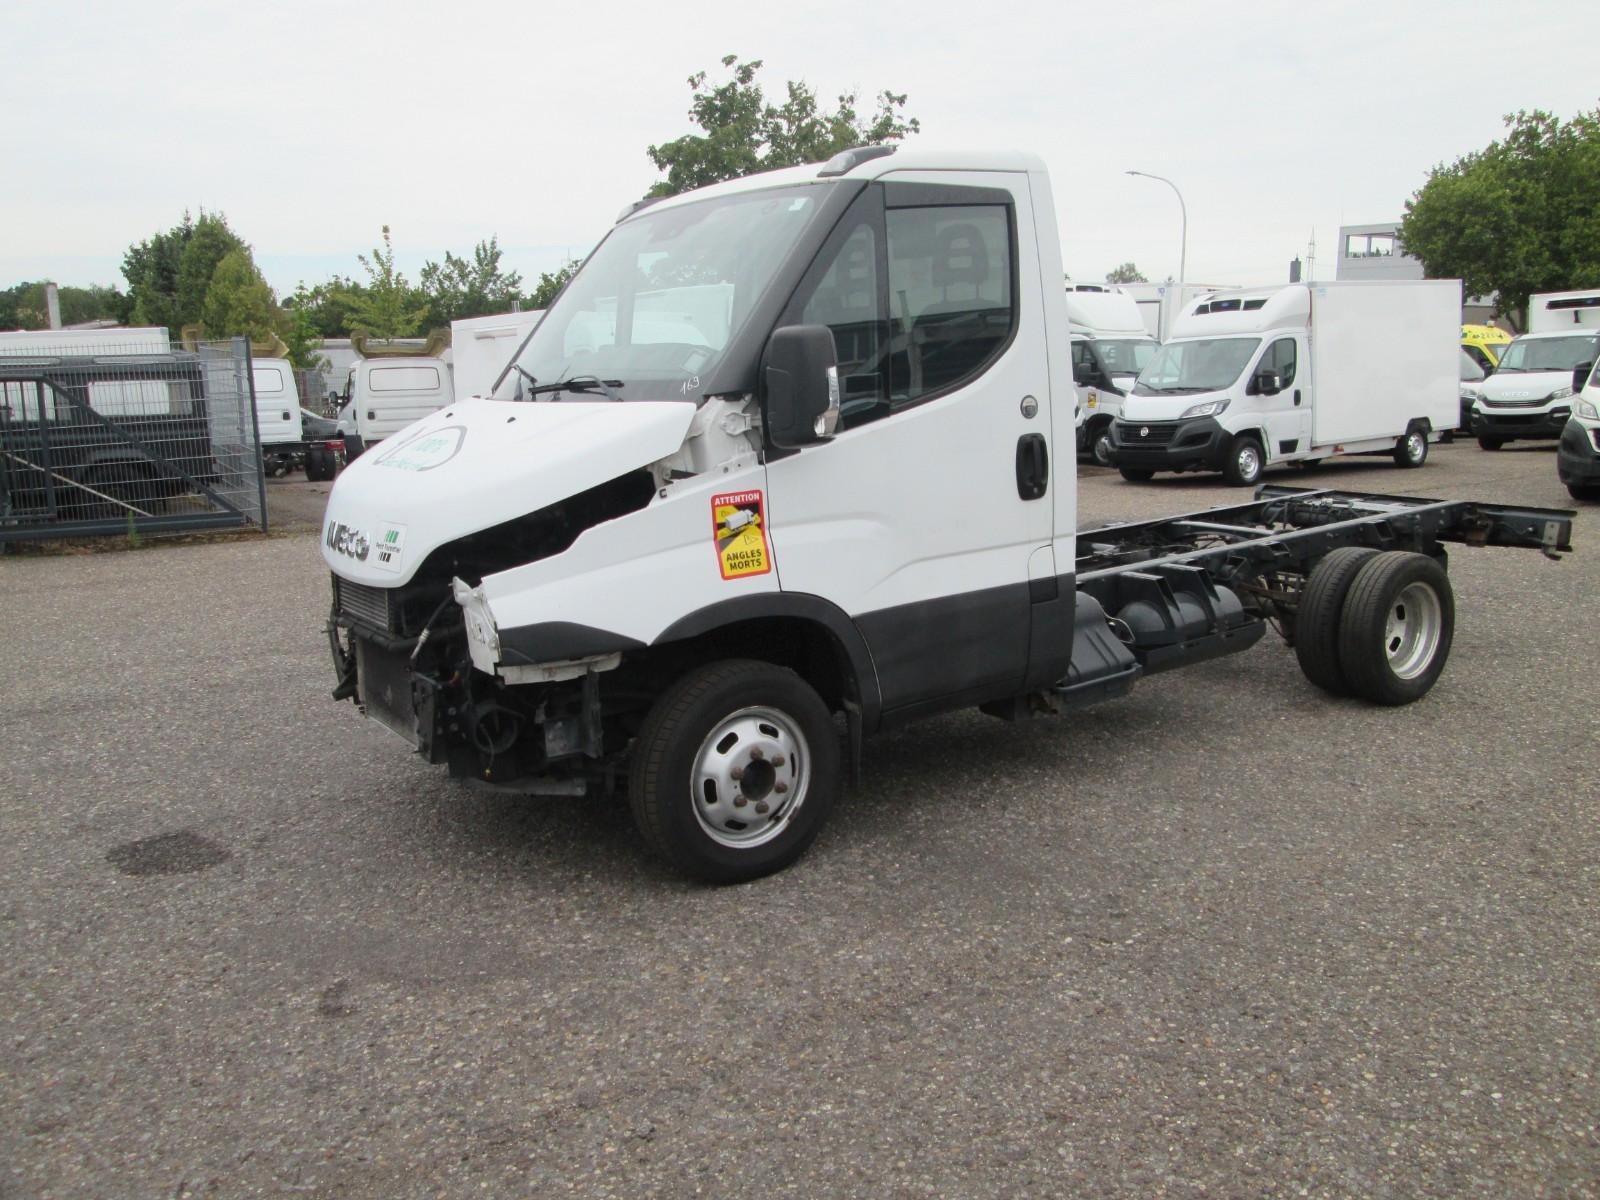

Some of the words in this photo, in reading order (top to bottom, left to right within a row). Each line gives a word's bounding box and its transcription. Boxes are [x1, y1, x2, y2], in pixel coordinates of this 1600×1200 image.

[714, 492, 760, 506] ATTENTION
[327, 520, 370, 561] IVECO
[726, 548, 762, 562] ANGLES
[729, 558, 762, 572] MORTS
